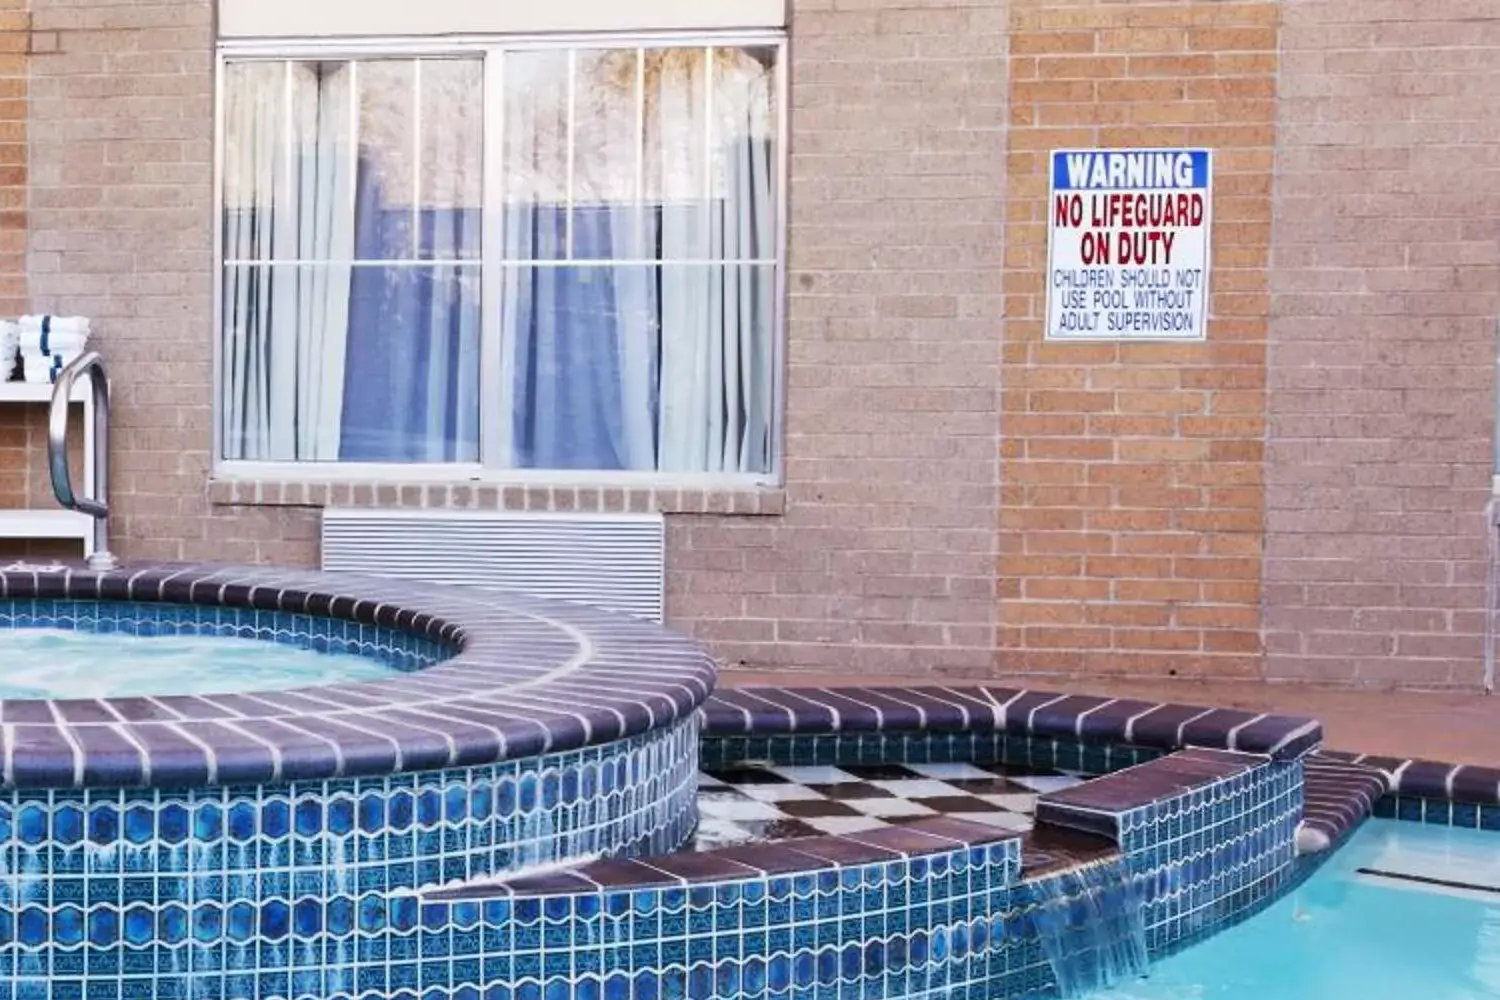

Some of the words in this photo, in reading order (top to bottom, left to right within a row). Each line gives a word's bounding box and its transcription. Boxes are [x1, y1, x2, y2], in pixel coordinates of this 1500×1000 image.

[1066, 153, 1193, 188] WARNING
[1056, 194, 1082, 227] NO
[1092, 193, 1203, 227] LIFEGUARD
[1081, 232, 1110, 264] ON
[1118, 232, 1174, 265] DUTY
[1054, 269, 1113, 288] CHILDREN
[1121, 269, 1171, 288] SHOULD
[1177, 269, 1201, 288] NOT
[1062, 290, 1086, 308] USE
[1094, 290, 1128, 309] POOL
[1134, 290, 1193, 309] WITHOUT
[1060, 312, 1100, 331] ADULT
[1108, 312, 1193, 331] SUPERVISION
